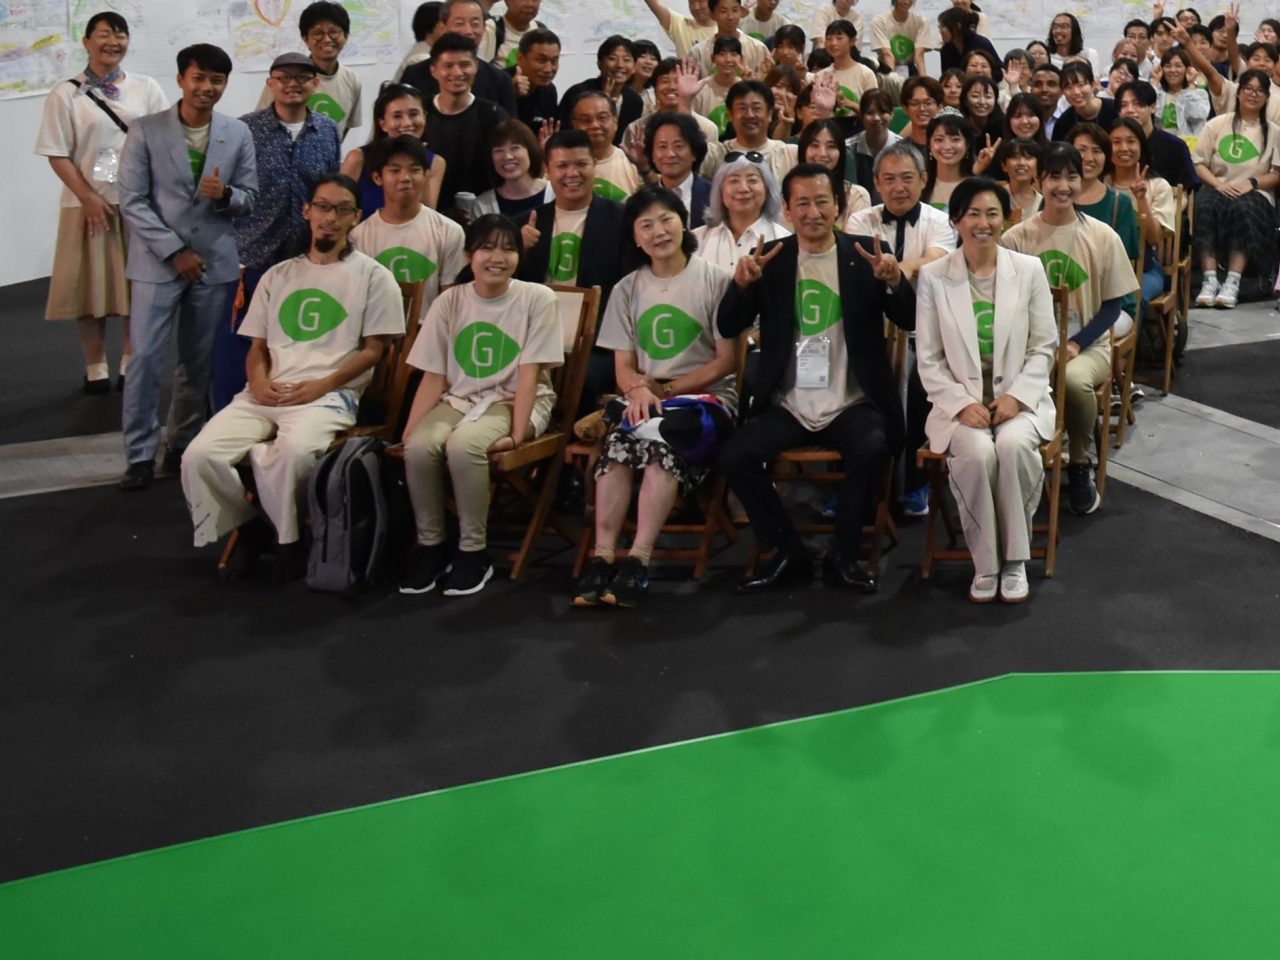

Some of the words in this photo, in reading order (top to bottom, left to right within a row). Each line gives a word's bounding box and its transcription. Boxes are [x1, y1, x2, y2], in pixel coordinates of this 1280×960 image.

[1229, 139, 1244, 159] G
[1047, 259, 1063, 289] G
[298, 297, 321, 331] G
[802, 289, 820, 325] G
[652, 313, 675, 348] G
[471, 331, 493, 367] G
